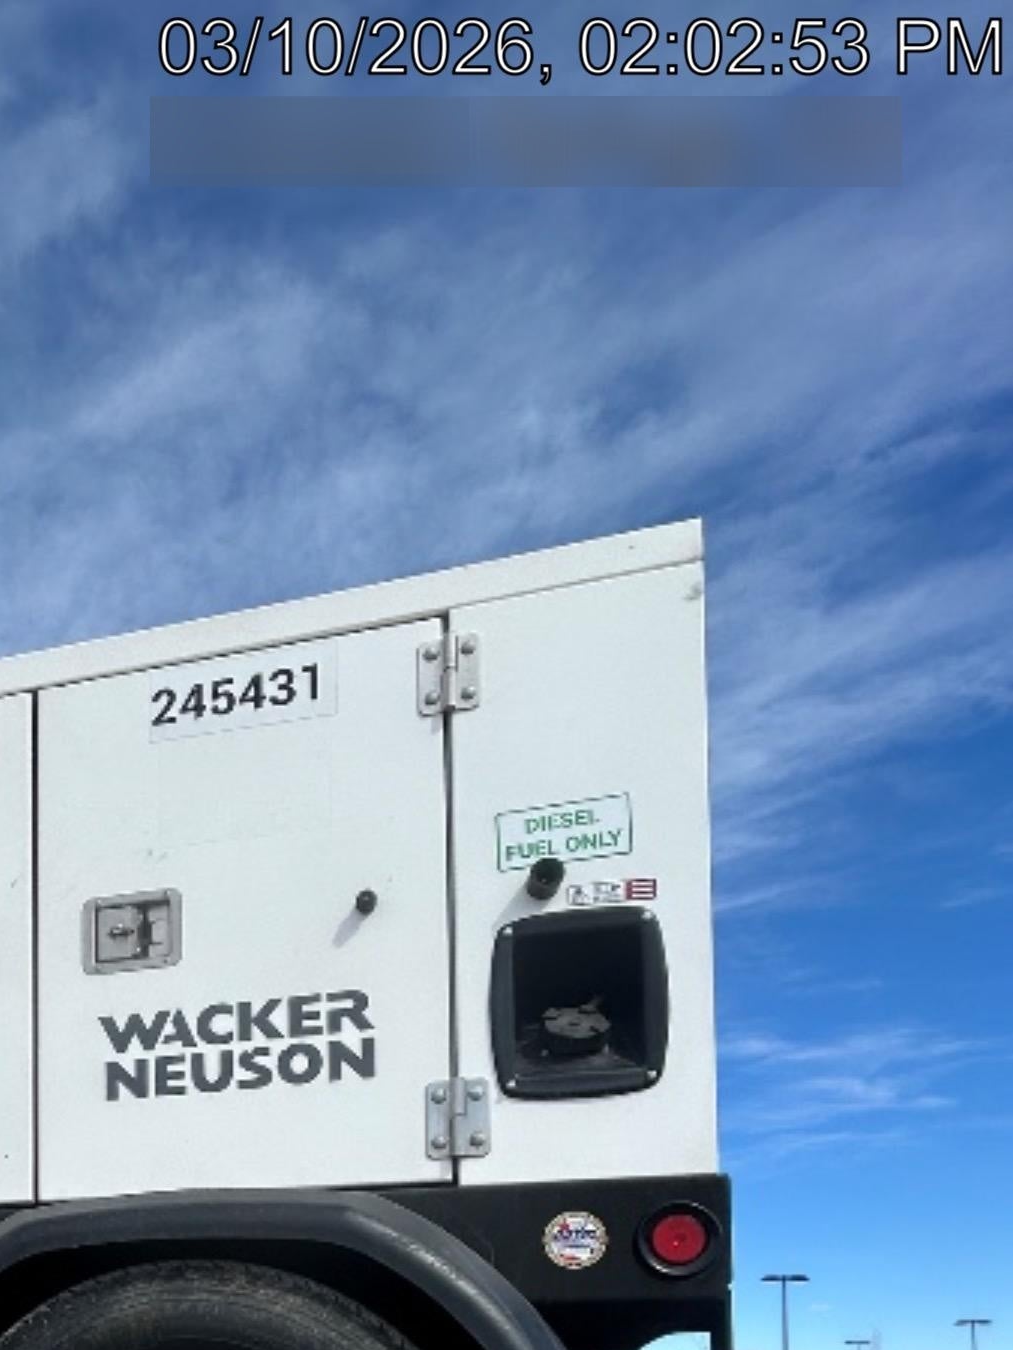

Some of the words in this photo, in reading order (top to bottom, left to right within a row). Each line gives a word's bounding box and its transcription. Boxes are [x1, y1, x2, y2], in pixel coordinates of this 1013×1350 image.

[151, 662, 319, 726] 245431
[505, 839, 557, 862] FUEL
[565, 829, 623, 853] ONLY
[524, 809, 600, 835] DIESEL
[97, 989, 375, 1053] WACKER
[105, 1037, 375, 1101] NEUSON
